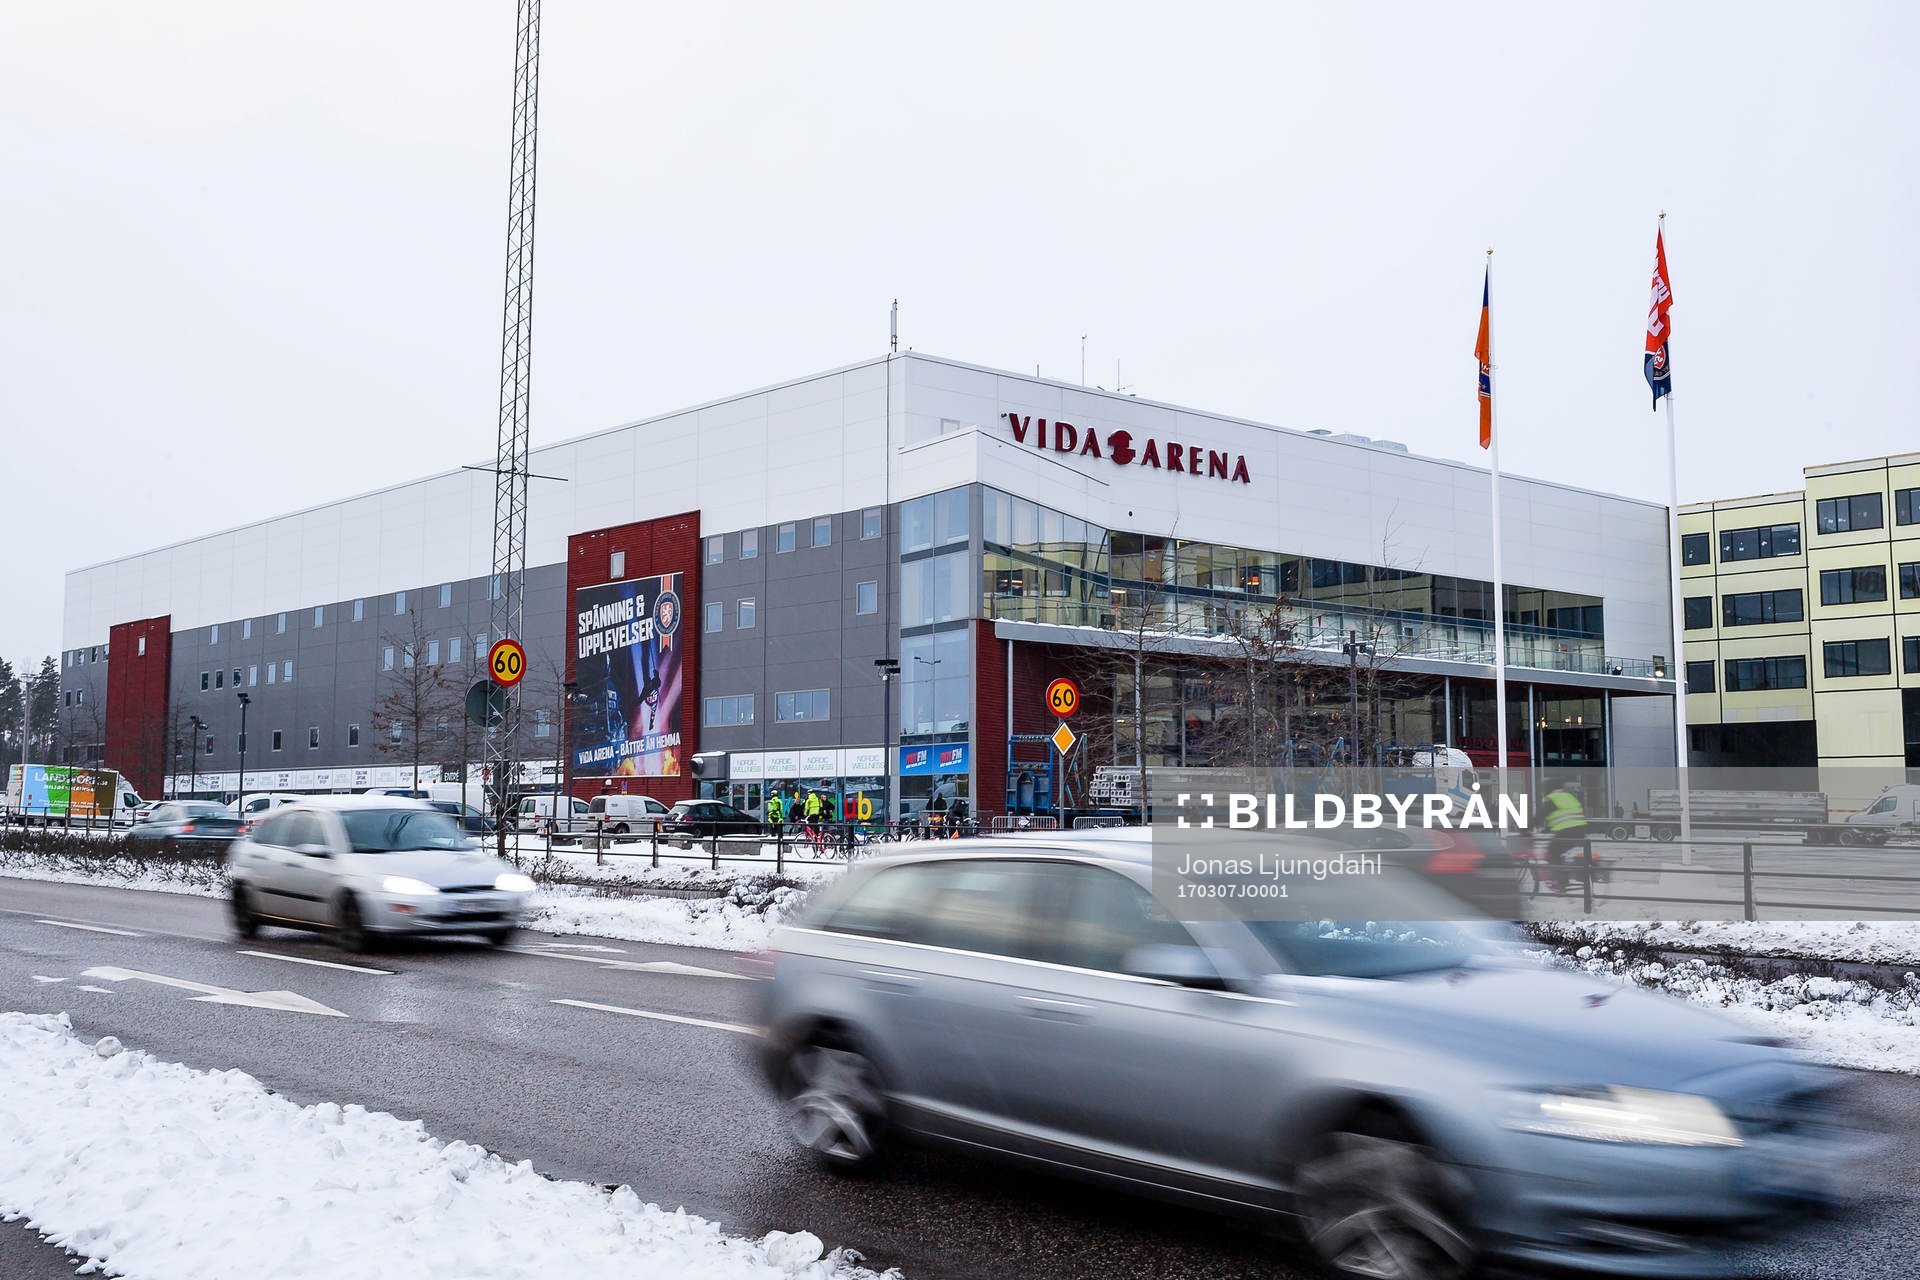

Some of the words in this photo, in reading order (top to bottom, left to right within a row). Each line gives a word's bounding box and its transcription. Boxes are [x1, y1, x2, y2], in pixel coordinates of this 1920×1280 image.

[1009, 412, 1101, 458] VIDA
[1141, 438, 1250, 483] ARENA
[578, 598, 634, 634] SPÄNNING
[636, 594, 645, 617] &
[578, 617, 654, 659] UPPLEVELSER
[494, 651, 521, 675] 60
[1052, 689, 1075, 707] 60
[578, 750, 593, 764] VIDA
[594, 746, 614, 762] ARENA
[620, 739, 645, 756] BÄTTRE
[646, 735, 656, 751] ÄN
[656, 732, 681, 749] HEMMA
[807, 756, 829, 764] NORDIC
[856, 754, 880, 763] NORDIC
